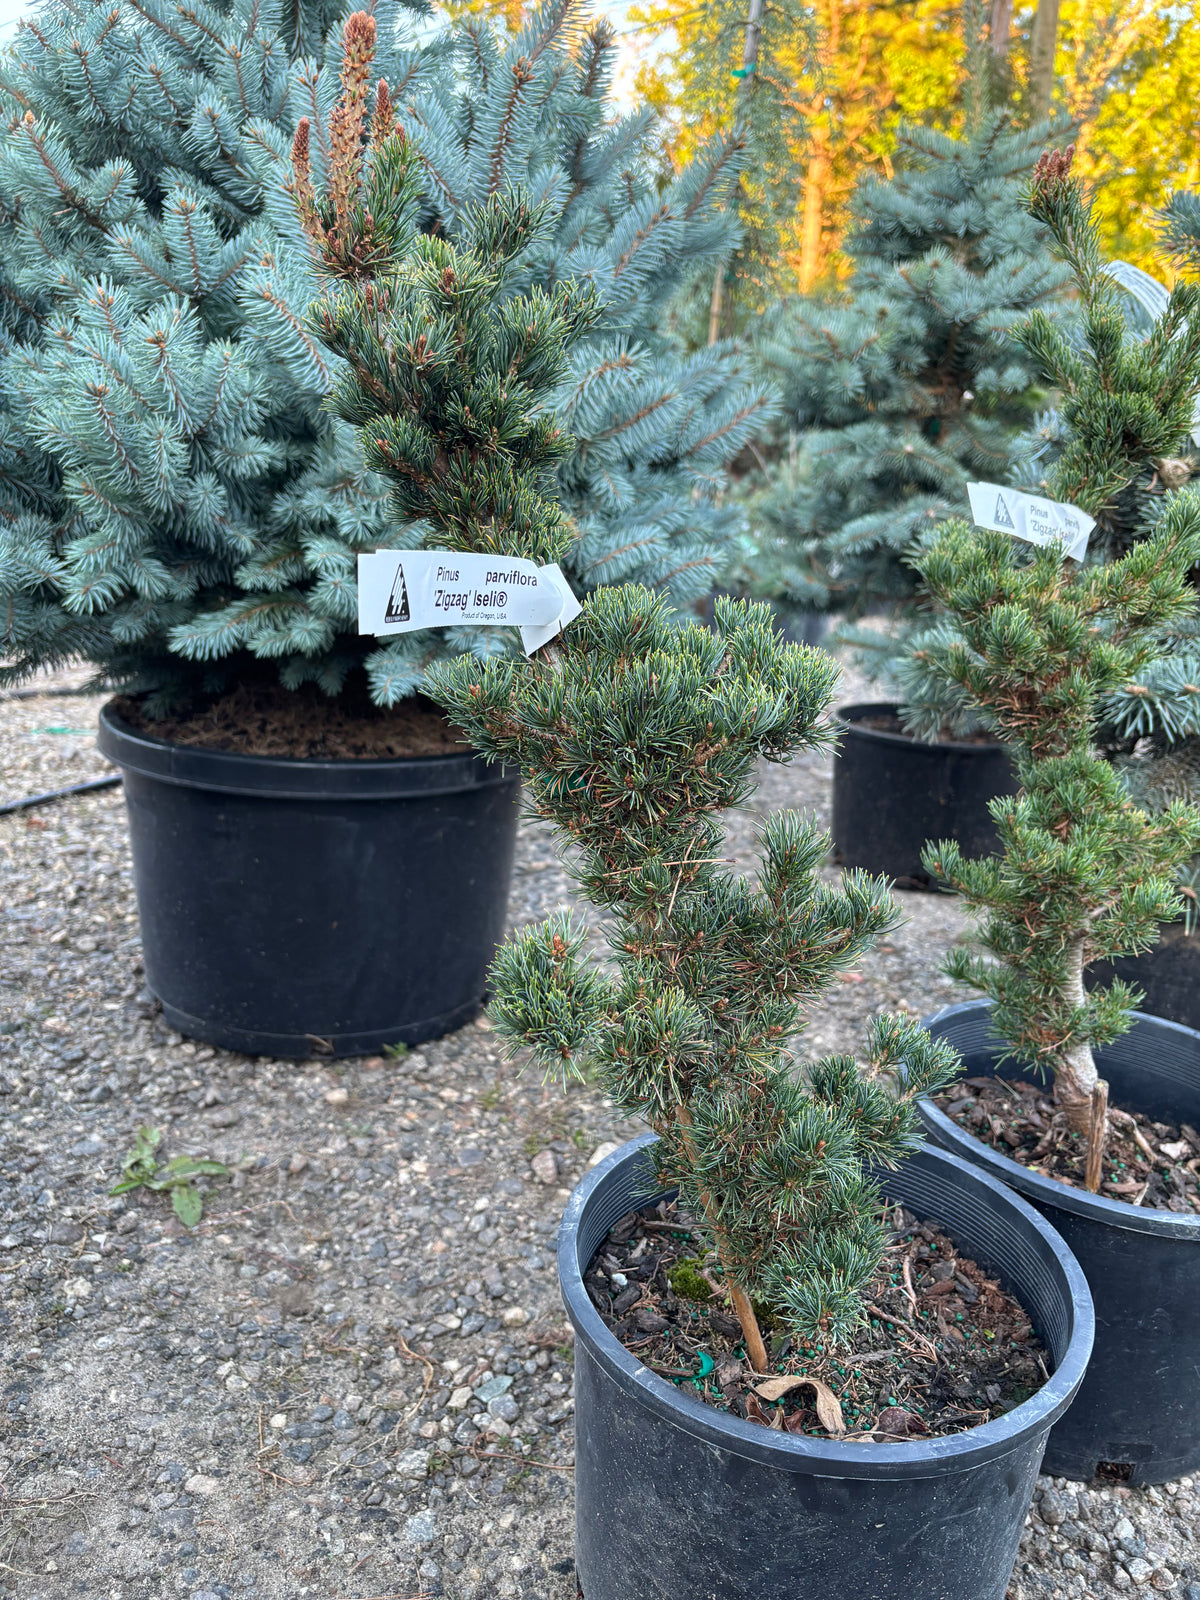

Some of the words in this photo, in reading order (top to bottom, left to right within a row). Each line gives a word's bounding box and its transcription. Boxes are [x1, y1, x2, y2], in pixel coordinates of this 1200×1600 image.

[1030, 505, 1049, 519] Pinus
[436, 566, 460, 582] Pinus
[485, 570, 538, 587] parviflora
[434, 589, 472, 612] 'Zigzag'
[496, 612, 507, 620] USA
